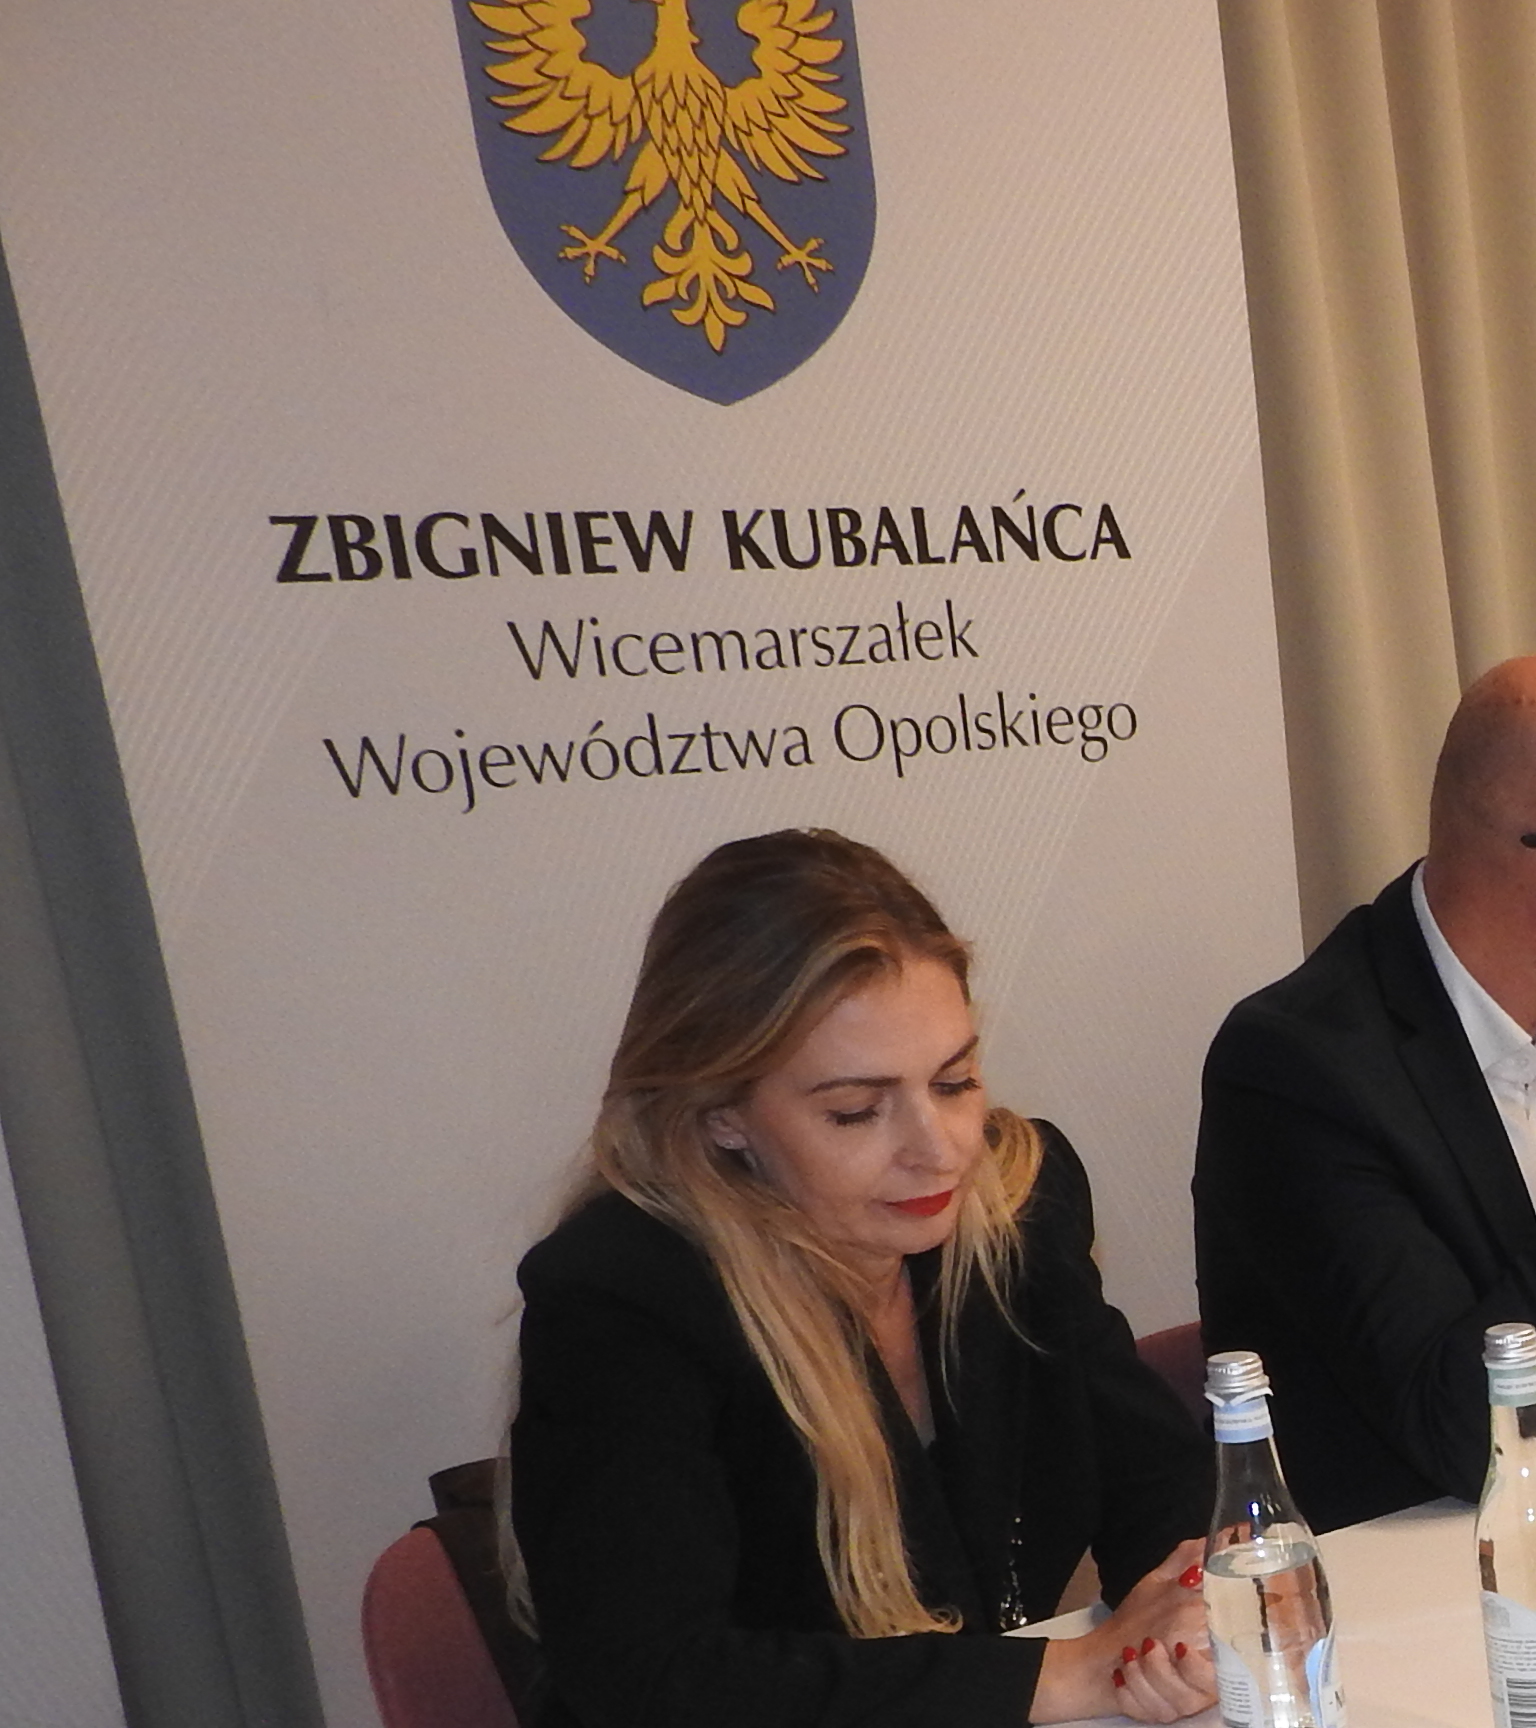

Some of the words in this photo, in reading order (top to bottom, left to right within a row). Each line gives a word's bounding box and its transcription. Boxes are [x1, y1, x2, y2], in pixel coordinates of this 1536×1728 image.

[269, 509, 694, 583] ZBIGNIEW
[722, 488, 1133, 571] KUBALAŃCA
[507, 599, 980, 681] Wicemarszałek
[322, 713, 814, 813] Województwa
[832, 690, 1138, 780] Opolskiego
